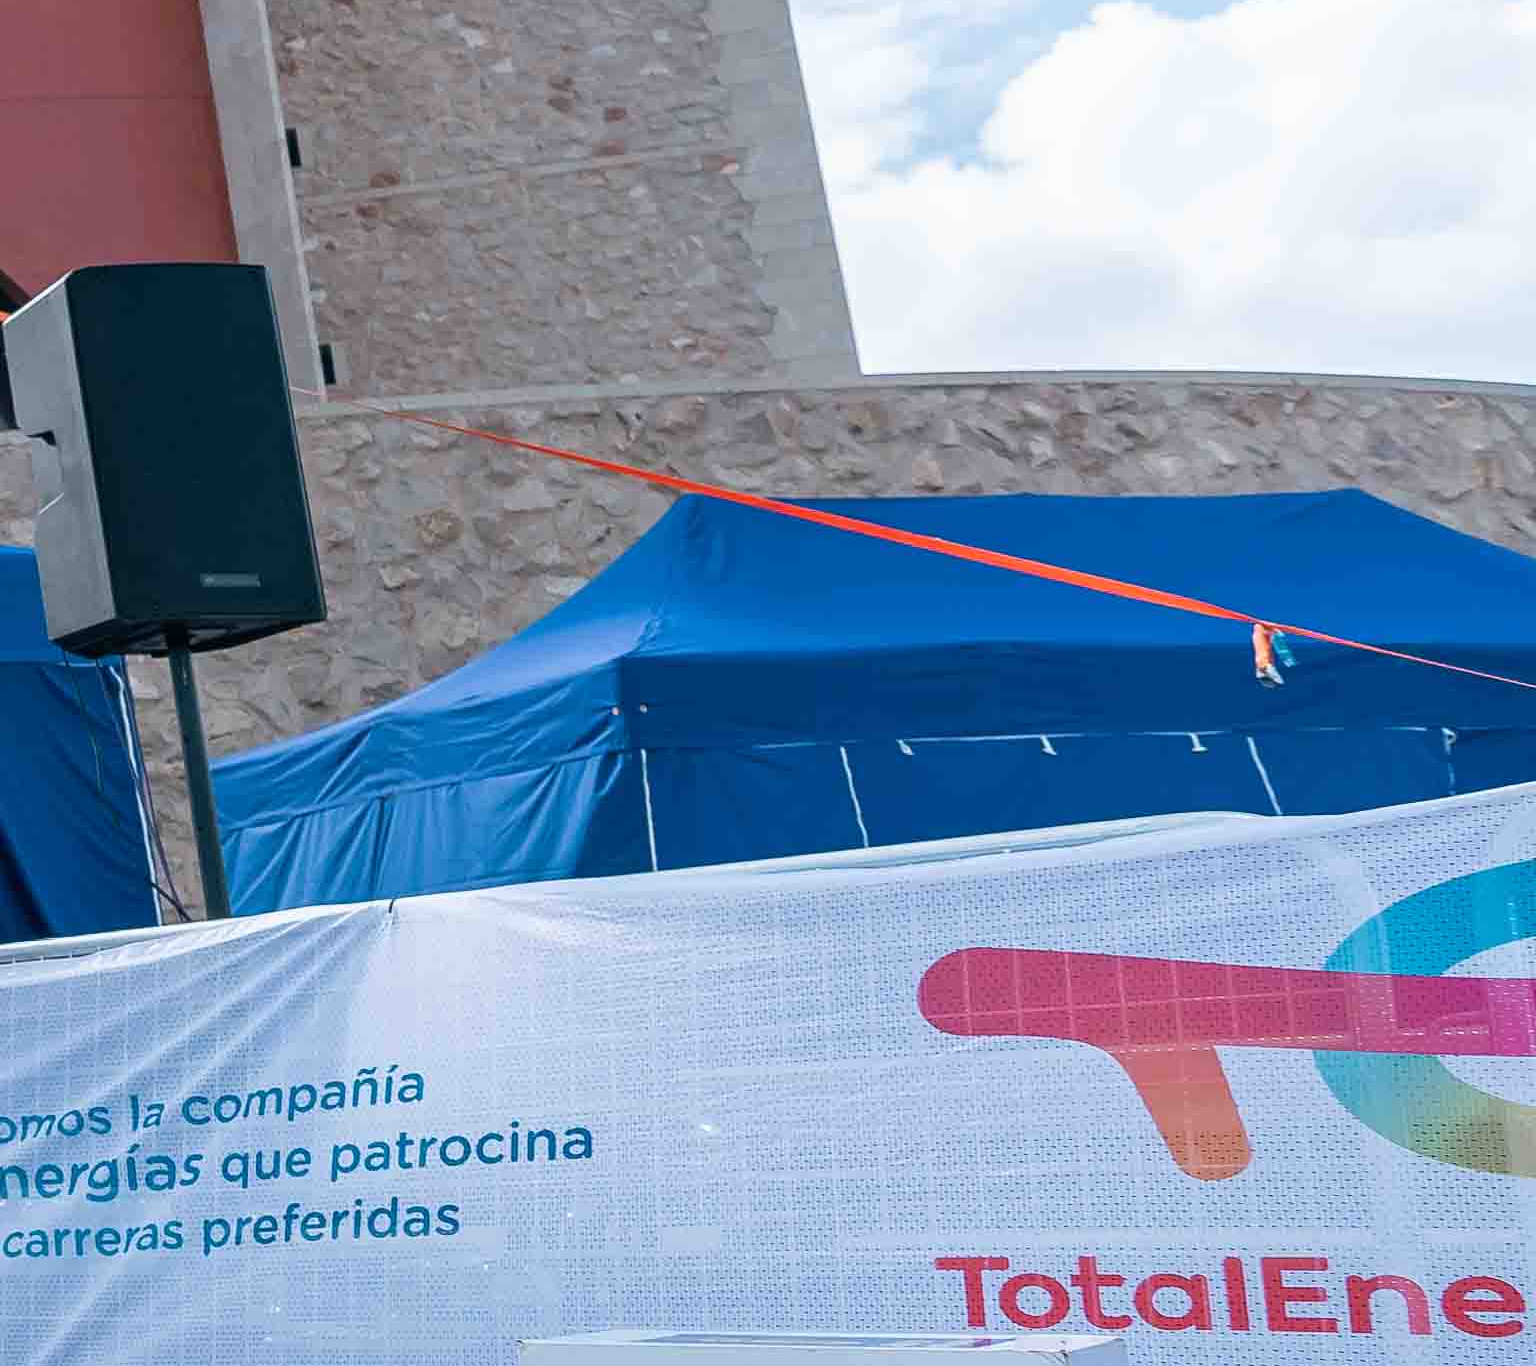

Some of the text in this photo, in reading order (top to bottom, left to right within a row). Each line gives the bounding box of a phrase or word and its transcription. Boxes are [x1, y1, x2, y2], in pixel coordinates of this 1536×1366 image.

[130, 1095, 165, 1131] la
[182, 1066, 425, 1127] compañía
[222, 1139, 310, 1189] que
[330, 1121, 594, 1182] patrocina
[2, 1218, 183, 1258] carreras
[202, 1197, 460, 1255] preferidas
[933, 1255, 1525, 1338] TotalEne
